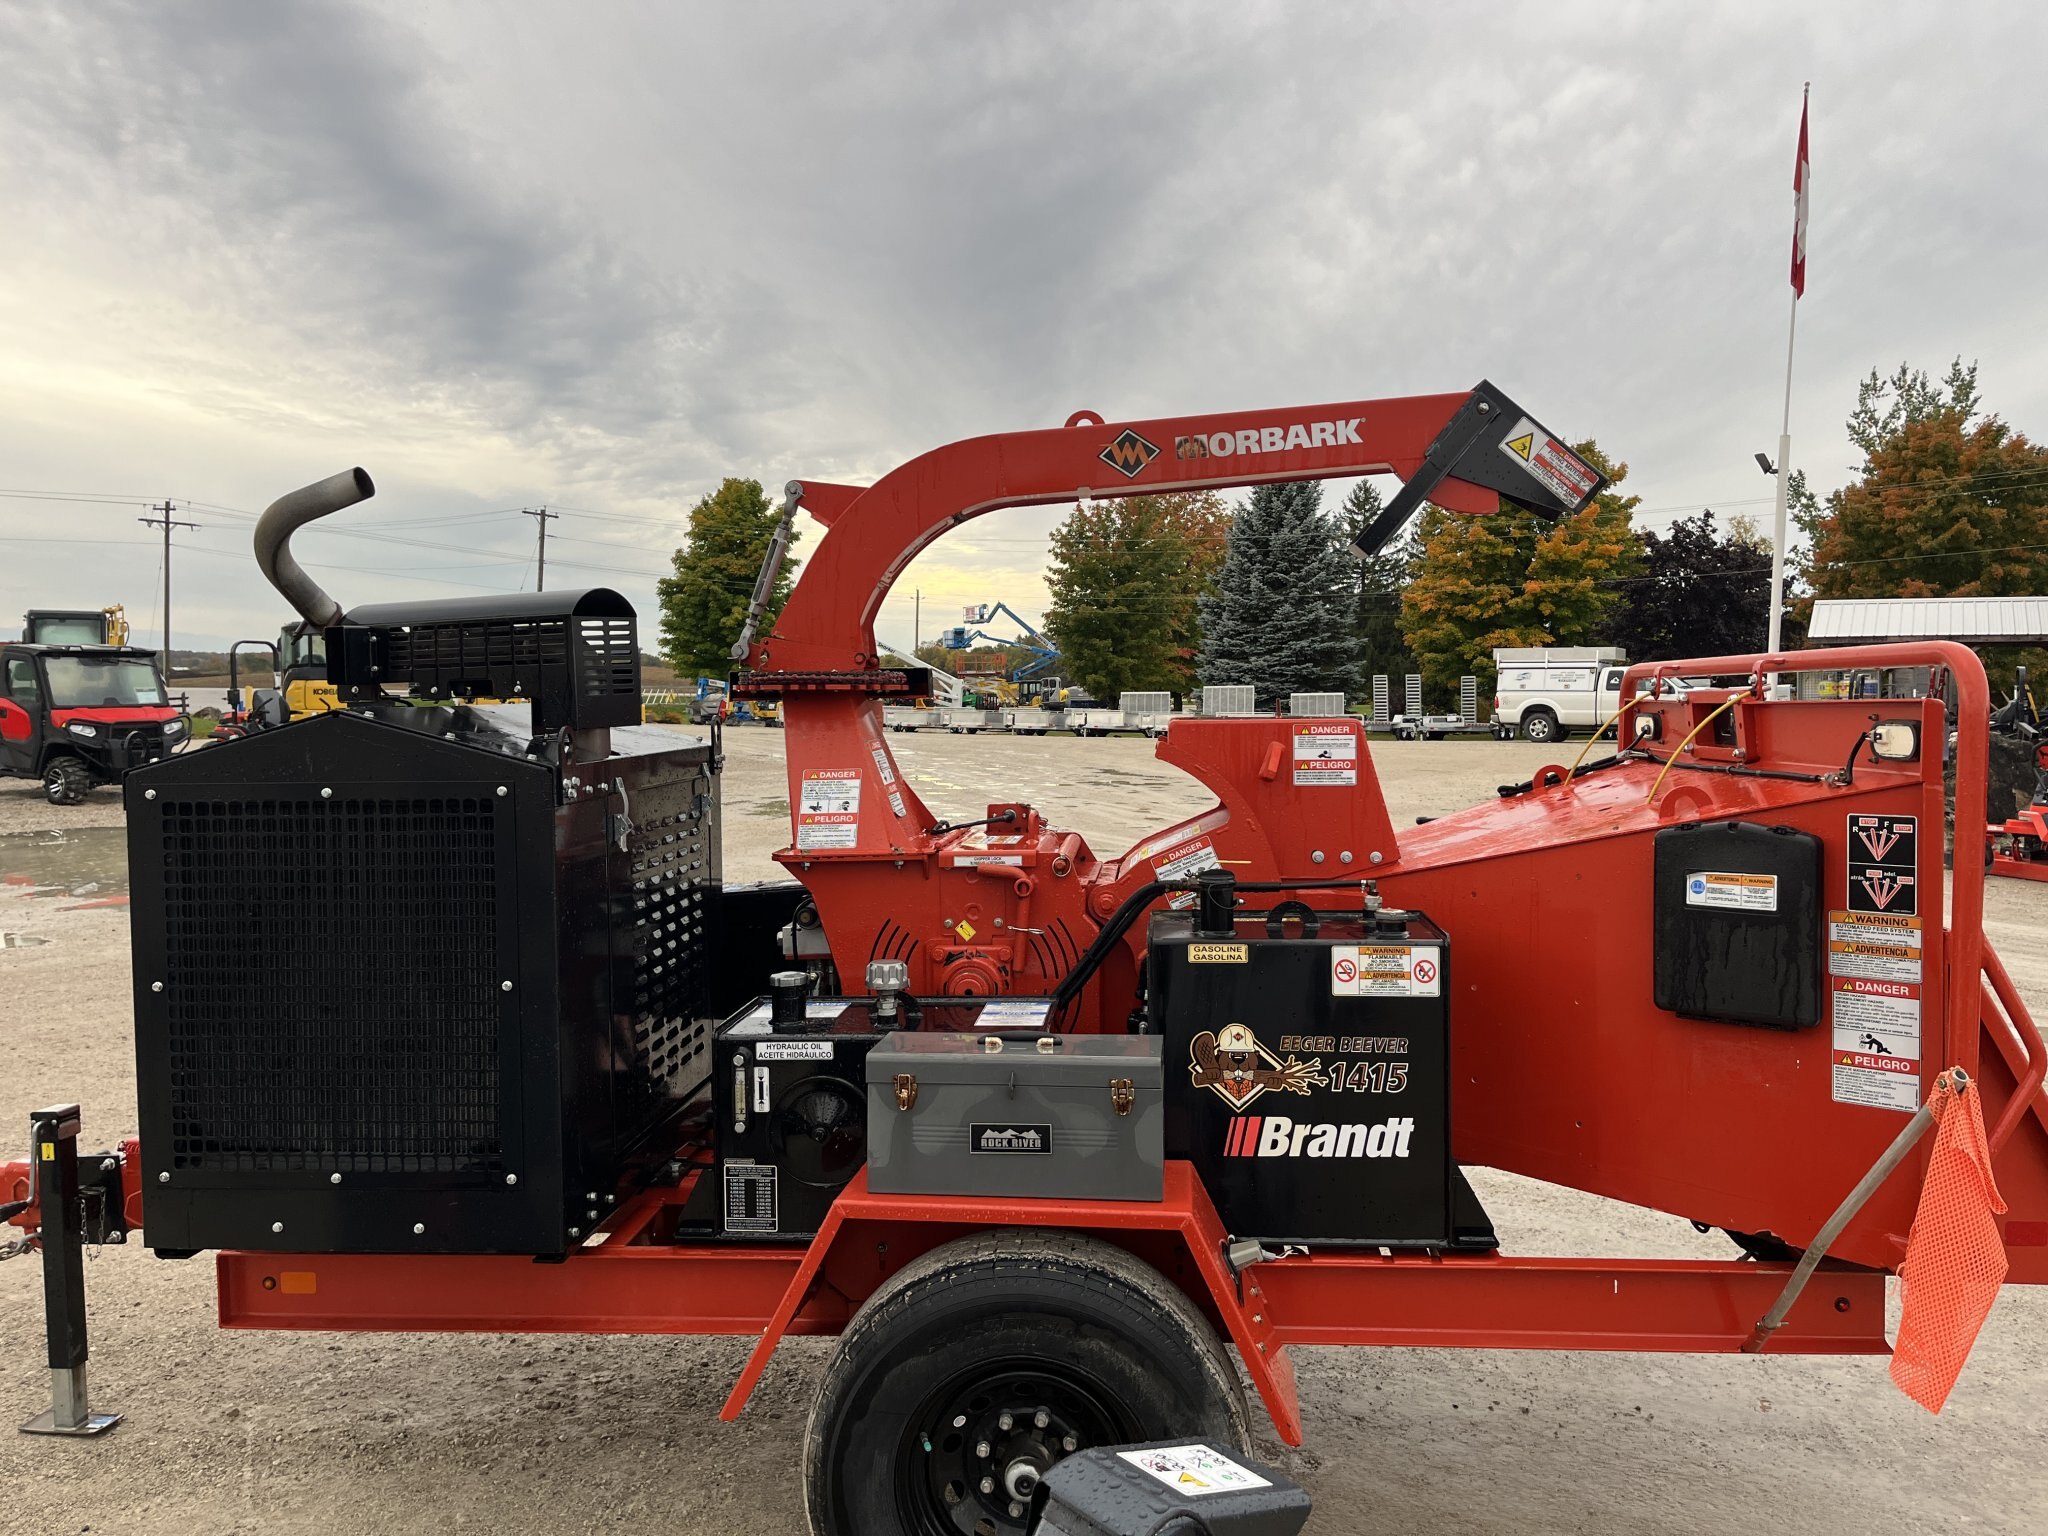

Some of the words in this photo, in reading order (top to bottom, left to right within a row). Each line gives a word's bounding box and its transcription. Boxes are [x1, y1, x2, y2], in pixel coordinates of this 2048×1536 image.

[1174, 418, 1364, 460] MORBARK
[1563, 453, 1585, 472] DANGER
[1532, 462, 1556, 482] MATERIAL
[1555, 481, 1579, 500] VOLANDO
[1550, 468, 1573, 488] PELIGRO
[1565, 462, 1588, 484] MATERIAL
[1310, 726, 1350, 734] DANGER
[1310, 761, 1351, 769] PELIGRO
[814, 815, 853, 823] PELIGRO
[1168, 842, 1203, 860] DANGER
[1855, 915, 1909, 927] WARNING
[1855, 944, 1909, 957] ADVERTENCIA
[1855, 981, 1909, 996] DANGER
[1279, 1035, 1335, 1052] EEGER
[1339, 1036, 1408, 1054] BEEVER
[786, 1050, 832, 1058] HIDRÁULICO
[1855, 1055, 1910, 1071] PELIGRO
[1328, 1062, 1408, 1094] 1415
[981, 1139, 1008, 1147] ROCK
[1012, 1139, 1041, 1148] RIVER
[1257, 1116, 1415, 1158] Brandt
